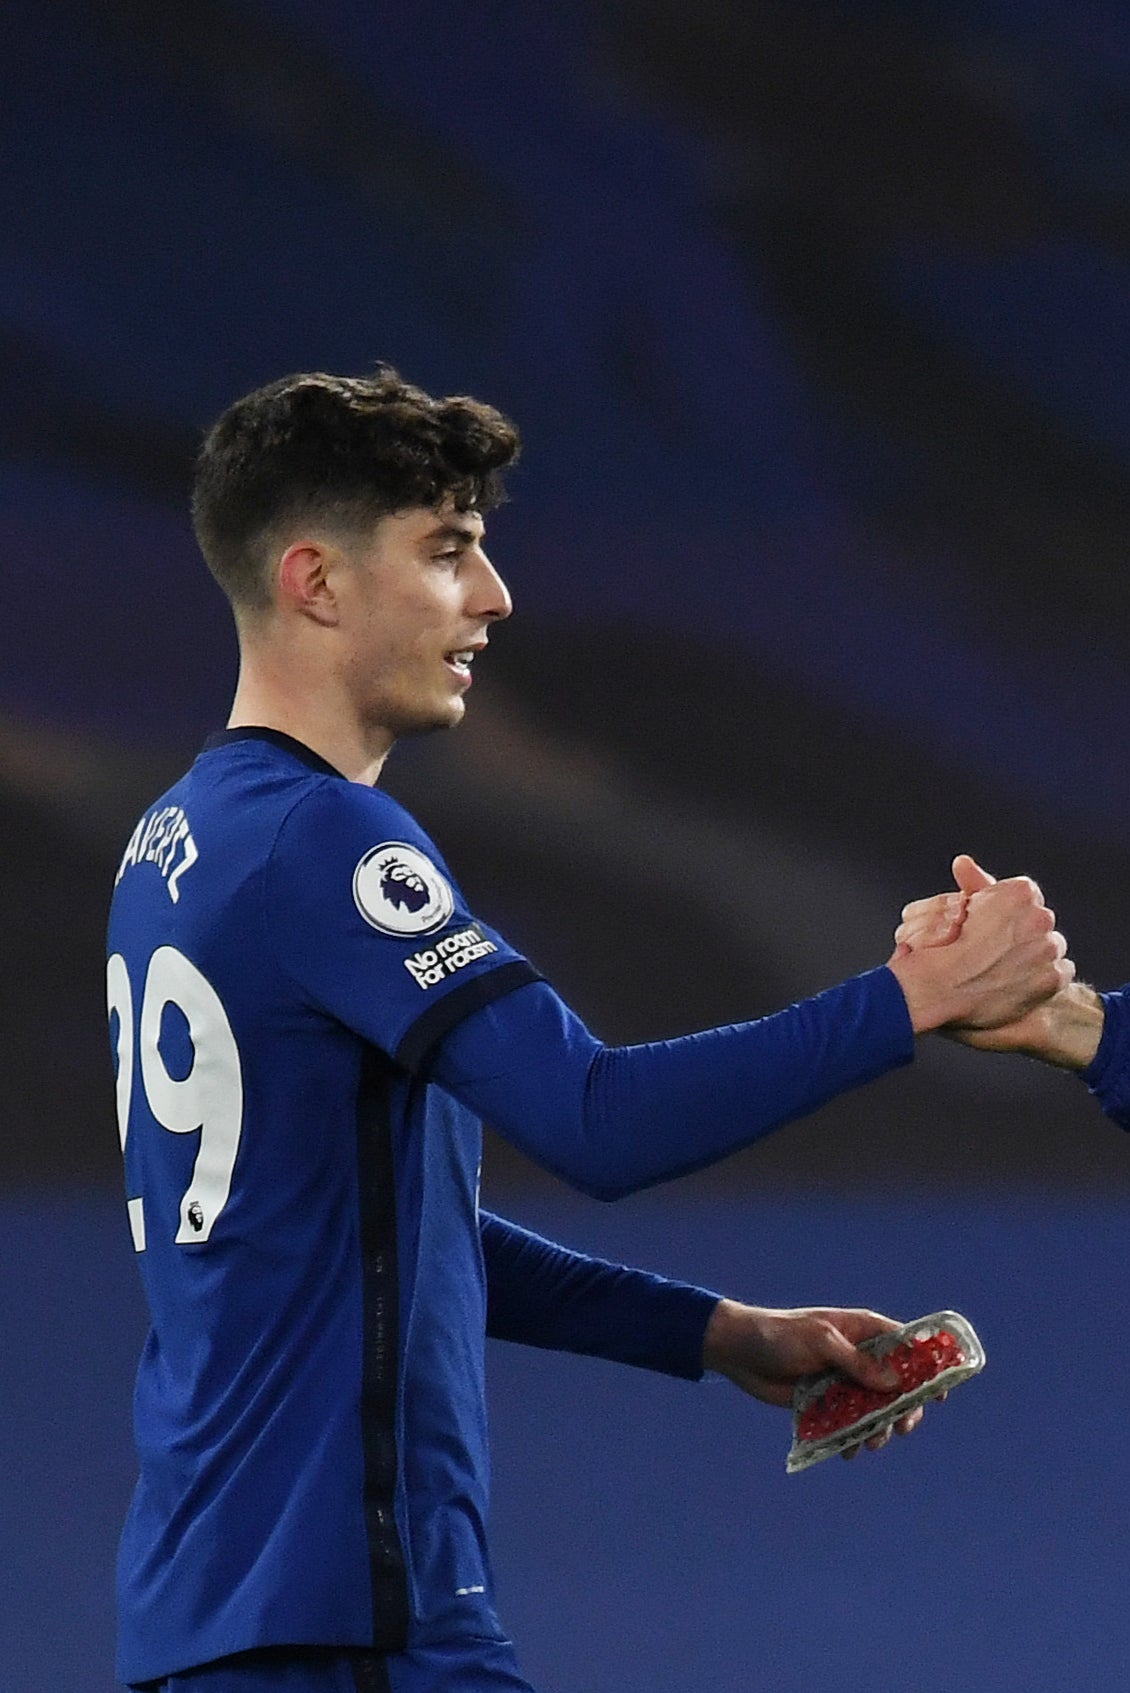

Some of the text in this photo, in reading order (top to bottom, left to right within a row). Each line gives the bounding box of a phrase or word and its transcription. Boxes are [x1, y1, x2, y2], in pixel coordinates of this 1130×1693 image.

[115, 806, 198, 904] AVERTZ
[404, 930, 481, 976] No room
[415, 963, 445, 990] for
